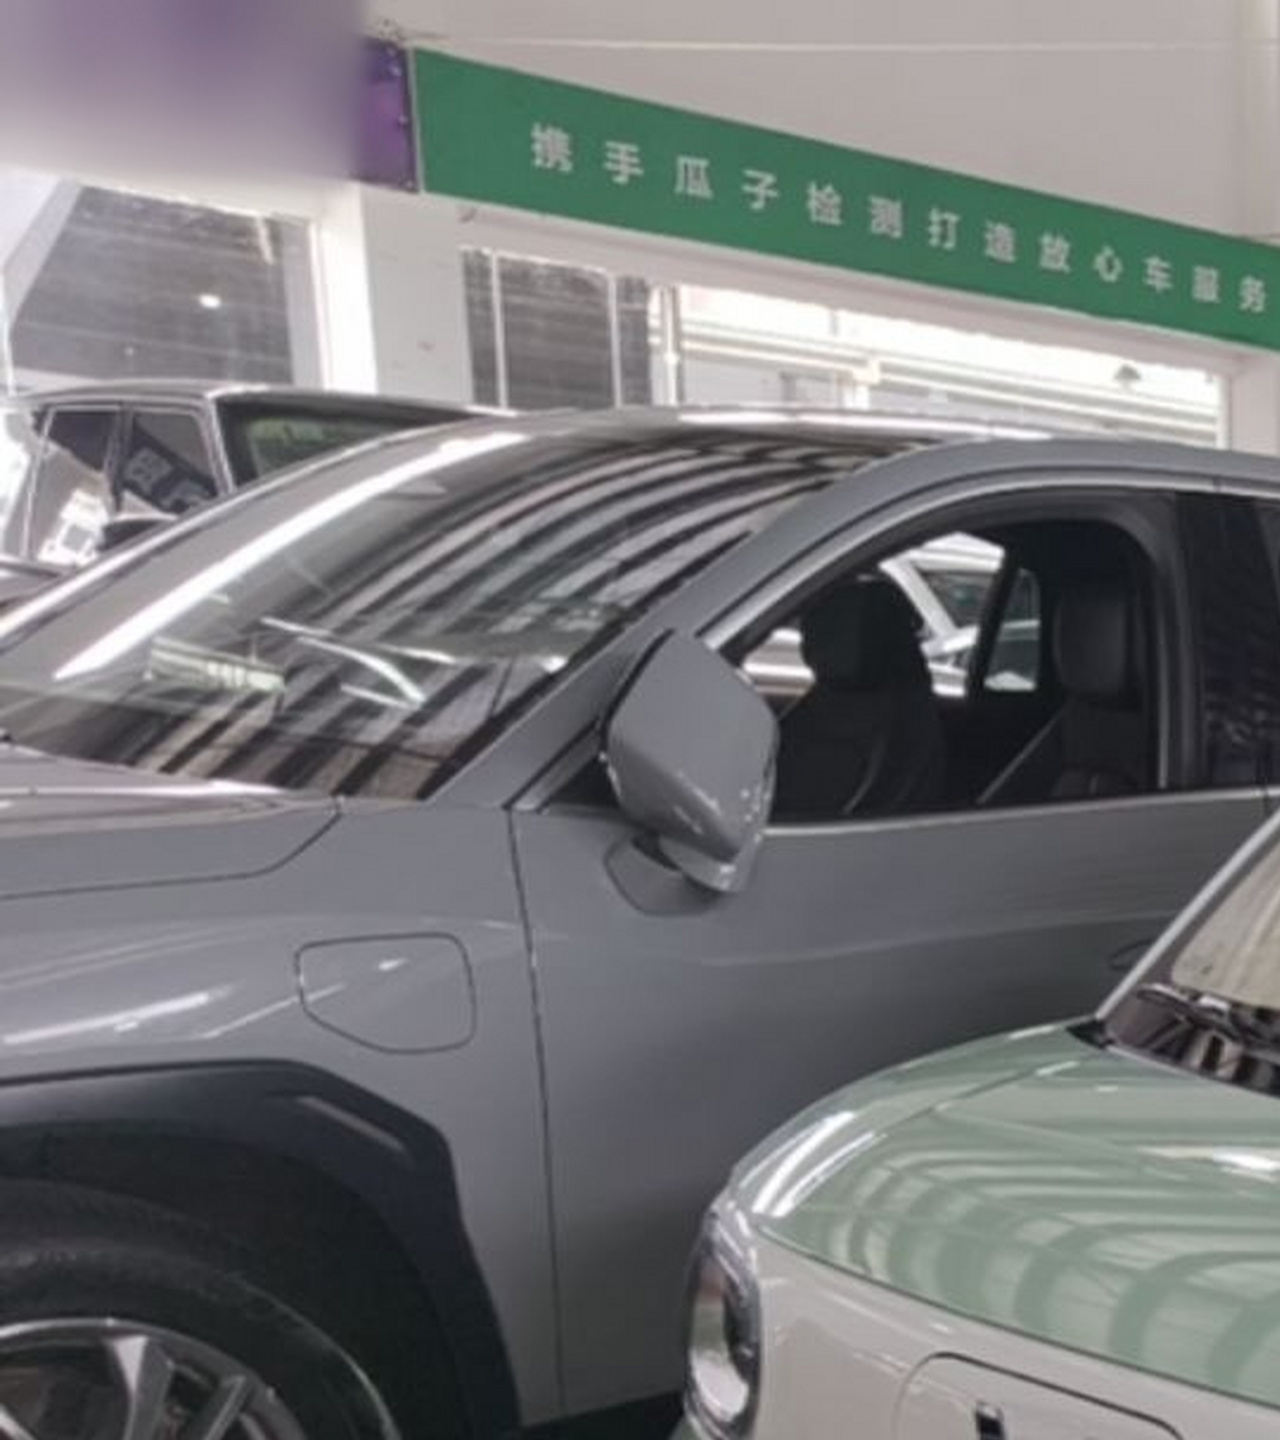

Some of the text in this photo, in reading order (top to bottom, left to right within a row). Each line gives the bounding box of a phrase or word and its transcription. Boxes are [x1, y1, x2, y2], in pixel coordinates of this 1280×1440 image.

[530, 122, 1269, 314] 携手瓜子检测打造放心车服务
